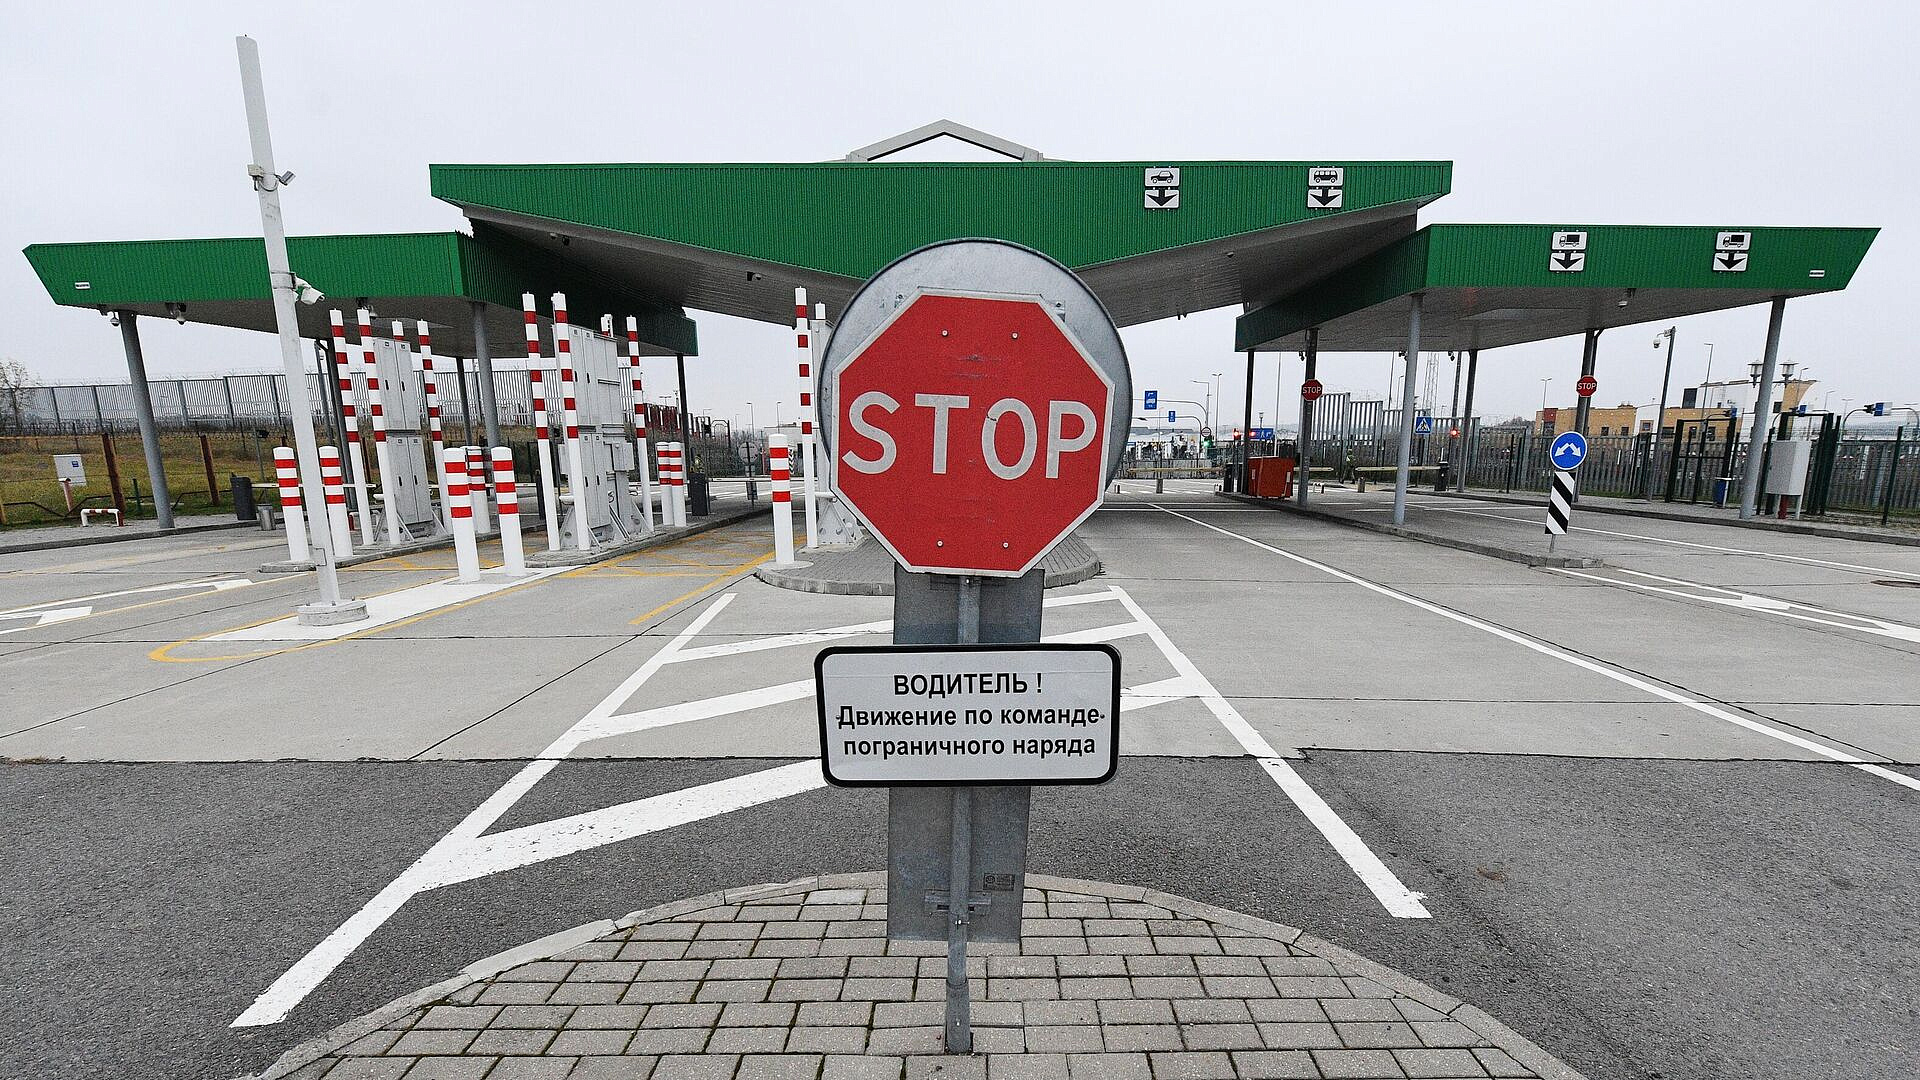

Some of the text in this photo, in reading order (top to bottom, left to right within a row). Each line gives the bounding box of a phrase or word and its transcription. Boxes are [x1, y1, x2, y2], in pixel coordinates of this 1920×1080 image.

[1302, 386, 1322, 394] STOP
[1577, 382, 1597, 390] STOP
[841, 391, 1097, 481] STOP
[893, 673, 1028, 699] ВОДИТЕЛЬ
[838, 705, 1100, 730] Движение по команде
[843, 737, 1096, 760] пограничного наряда
